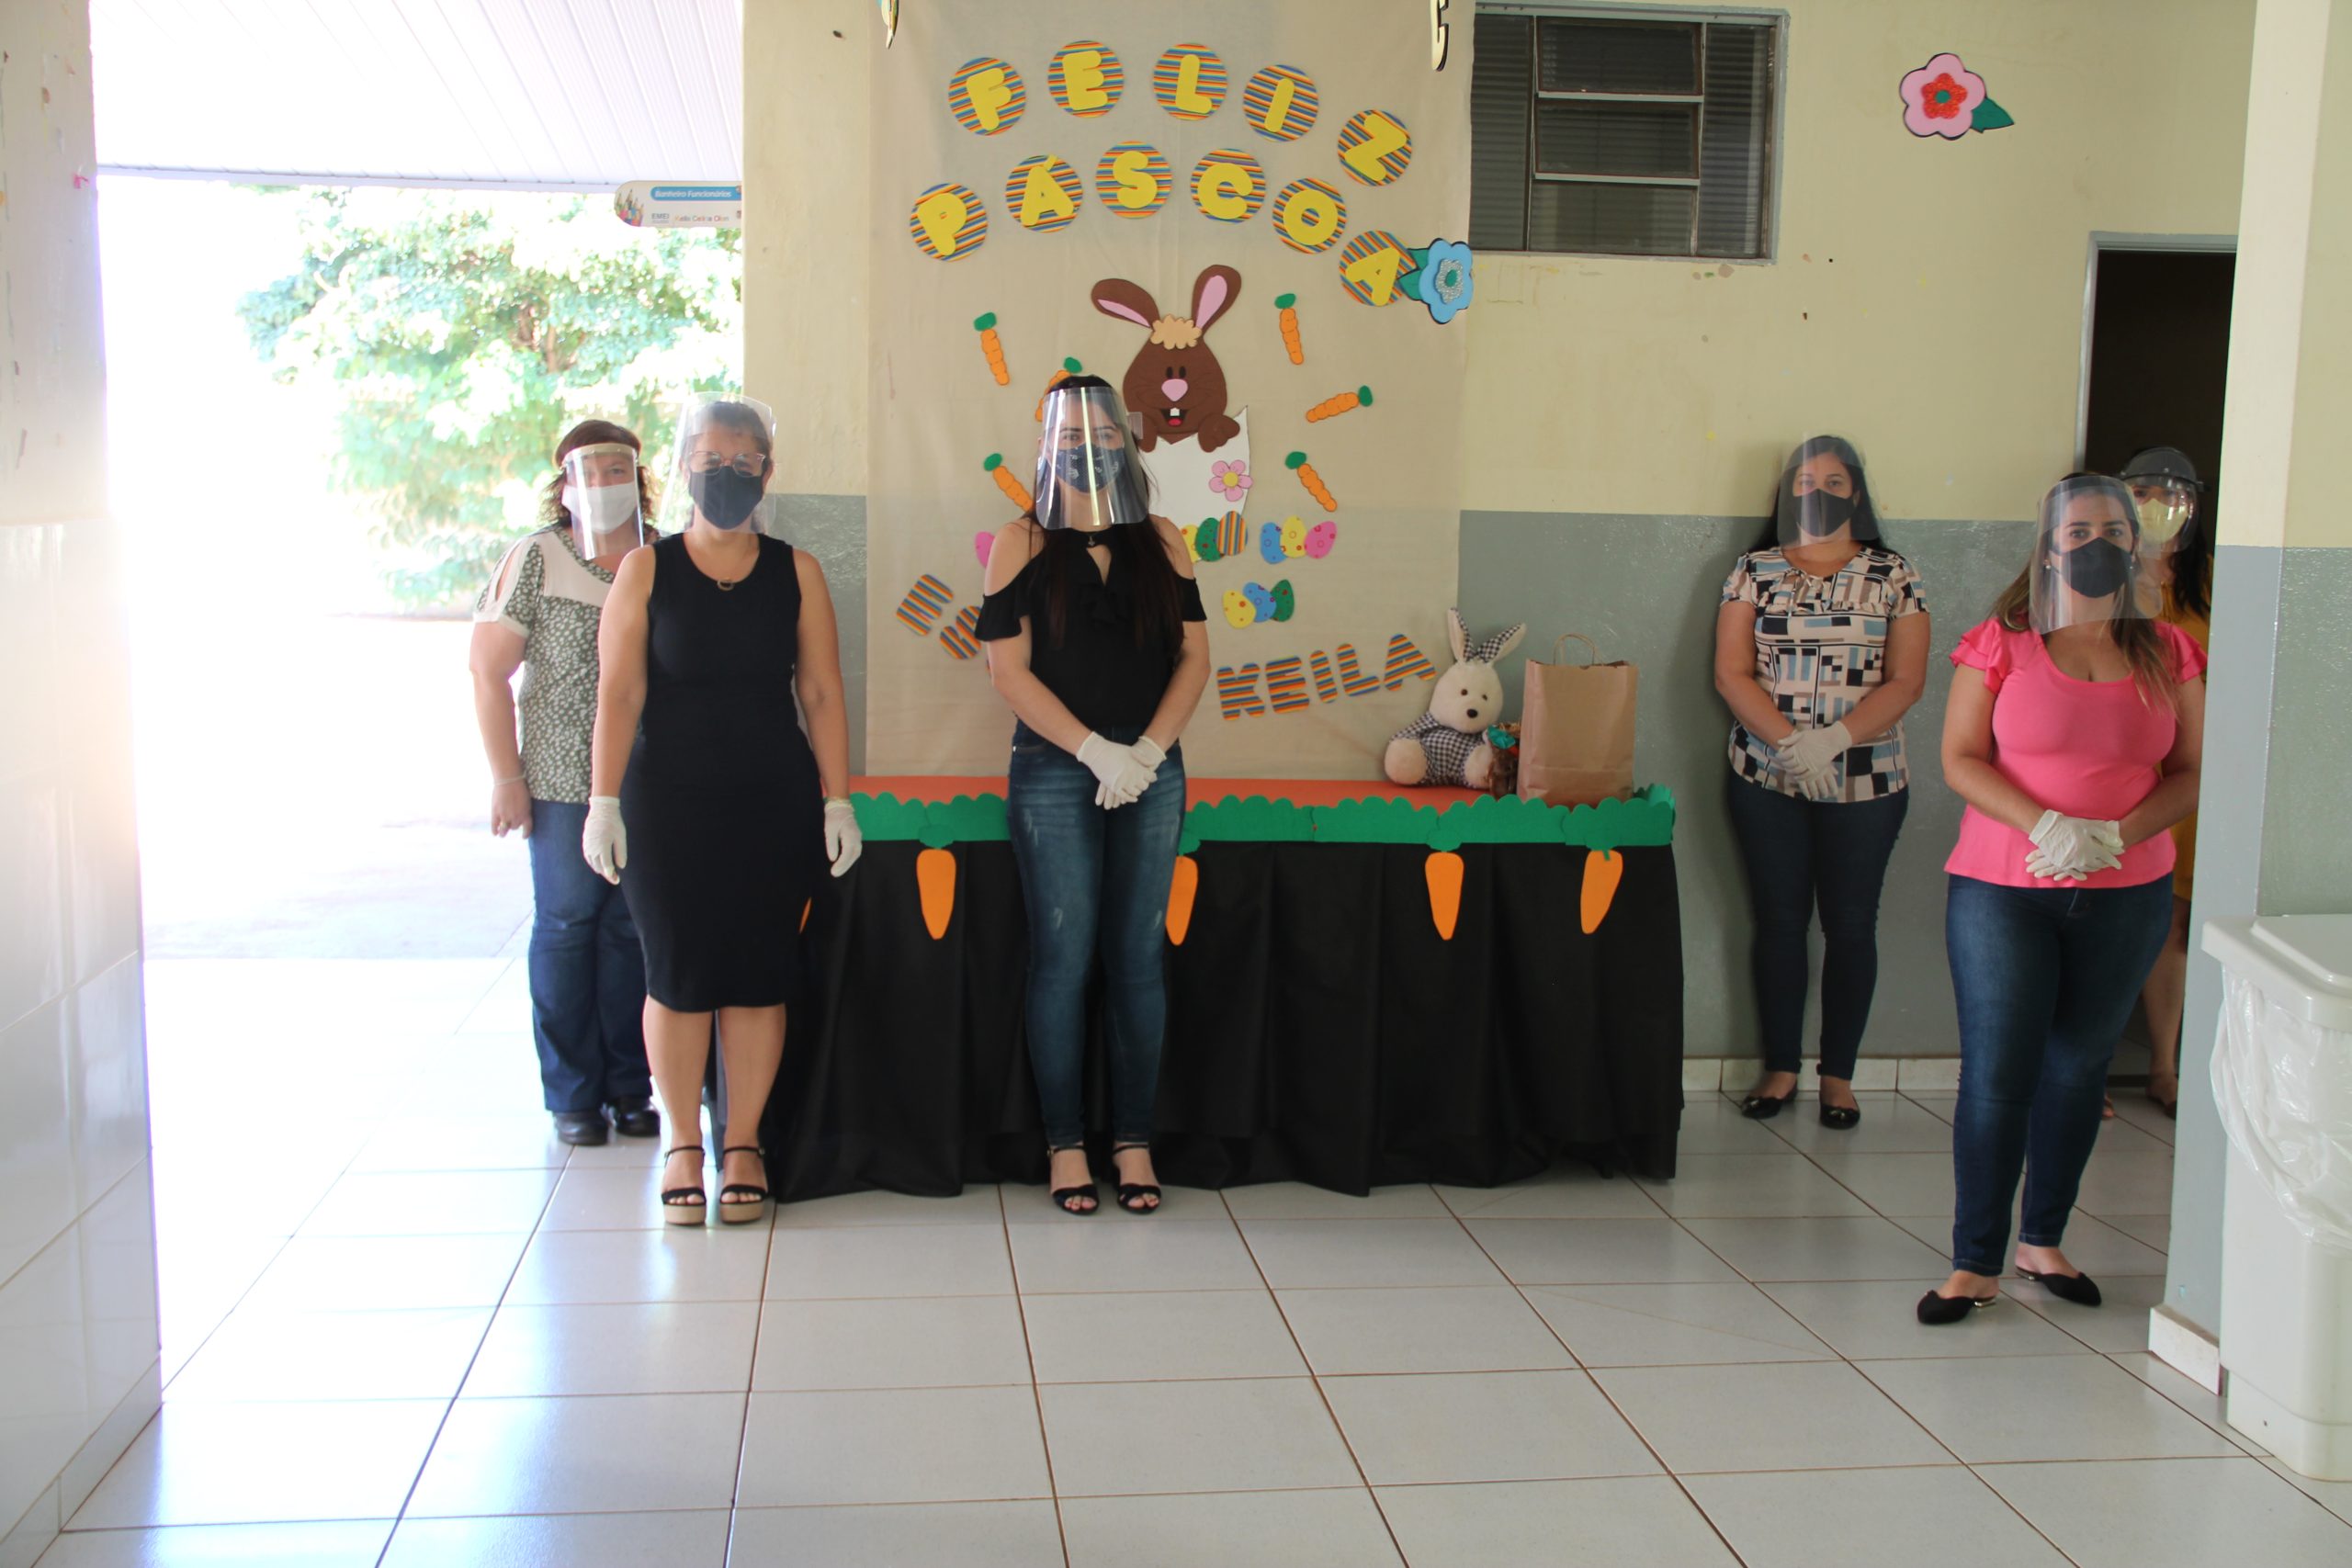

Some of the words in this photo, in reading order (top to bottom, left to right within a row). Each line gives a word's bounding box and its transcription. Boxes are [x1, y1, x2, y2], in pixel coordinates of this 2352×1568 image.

[966, 50, 1407, 183] FELIZ
[918, 151, 1401, 306] PÁSCOA
[1217, 633, 1437, 722] KEILA
